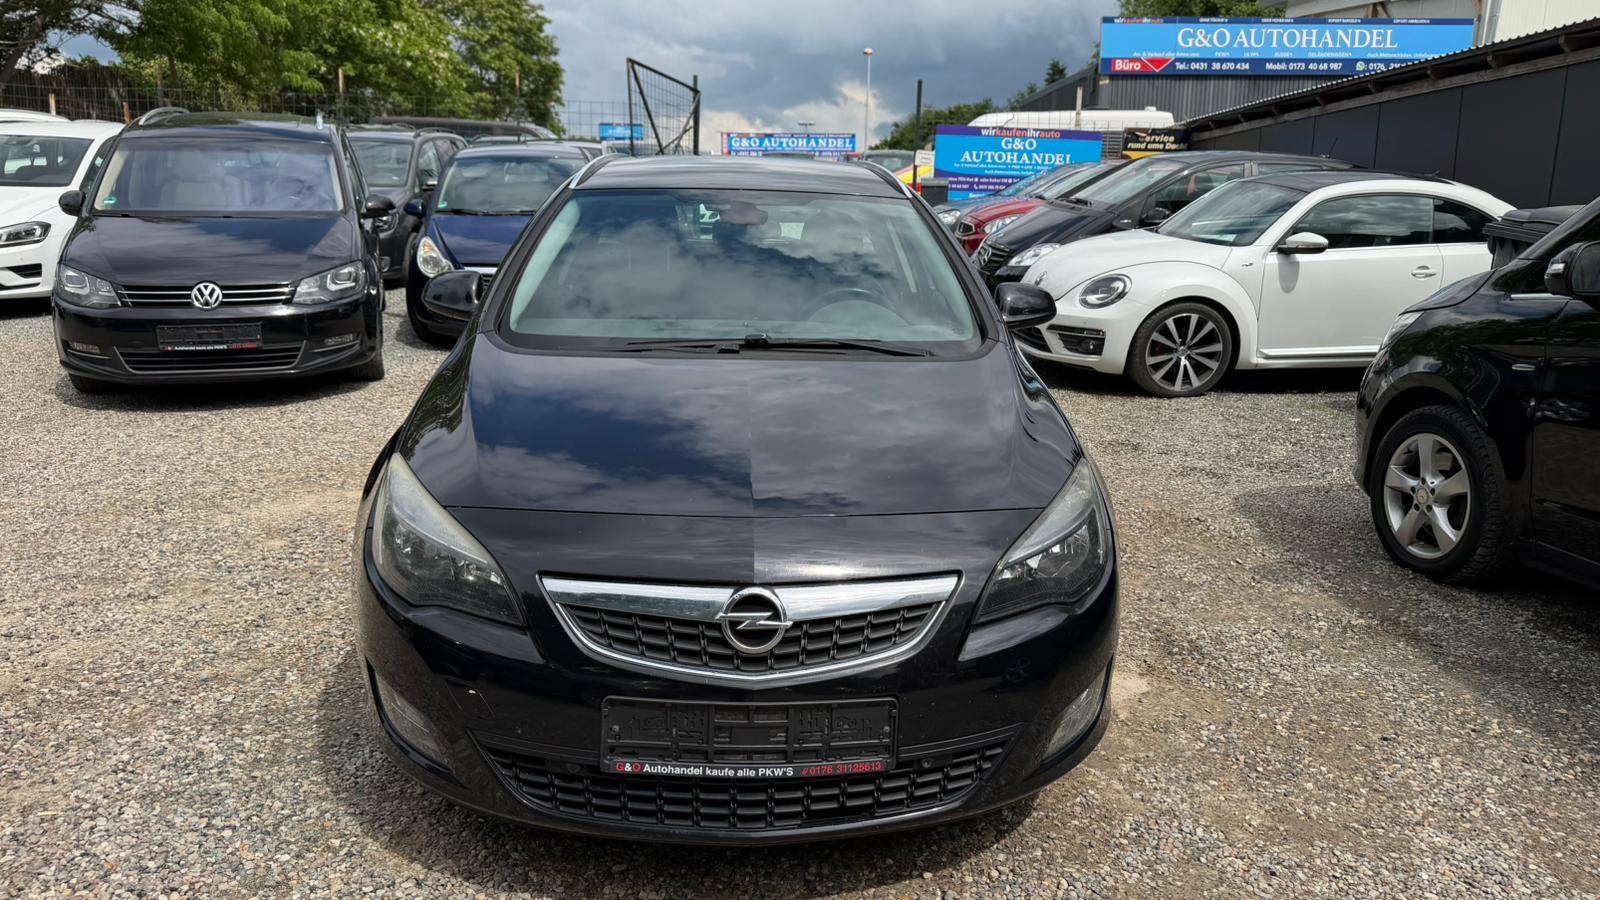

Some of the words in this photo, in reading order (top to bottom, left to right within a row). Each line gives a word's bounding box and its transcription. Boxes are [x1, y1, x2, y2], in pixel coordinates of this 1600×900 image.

[1177, 27, 1231, 48] G&O
[1233, 28, 1398, 48] AUTOHANDEL
[1115, 59, 1141, 70] Büro
[1175, 62, 1189, 70] Tel.:
[1190, 62, 1208, 70] 0431
[1211, 62, 1221, 70] 38
[1222, 62, 1235, 70] 670
[1236, 62, 1250, 70] 434
[1265, 62, 1287, 70] Mobil:
[1288, 62, 1305, 70] 0173
[981, 128, 1061, 138] wirkaufenihrauto
[1139, 134, 1175, 142] ervice
[731, 137, 759, 148] G&O
[762, 137, 852, 148] AUTOHANDEL
[1001, 138, 1037, 150] G&O
[616, 762, 641, 773] G&O
[643, 763, 703, 775] Autohandel
[705, 766, 734, 777] kaufe
[737, 767, 756, 777] alle
[758, 767, 794, 777] PKW'S
[809, 764, 833, 775] 0176
[836, 761, 882, 774] 31125613
